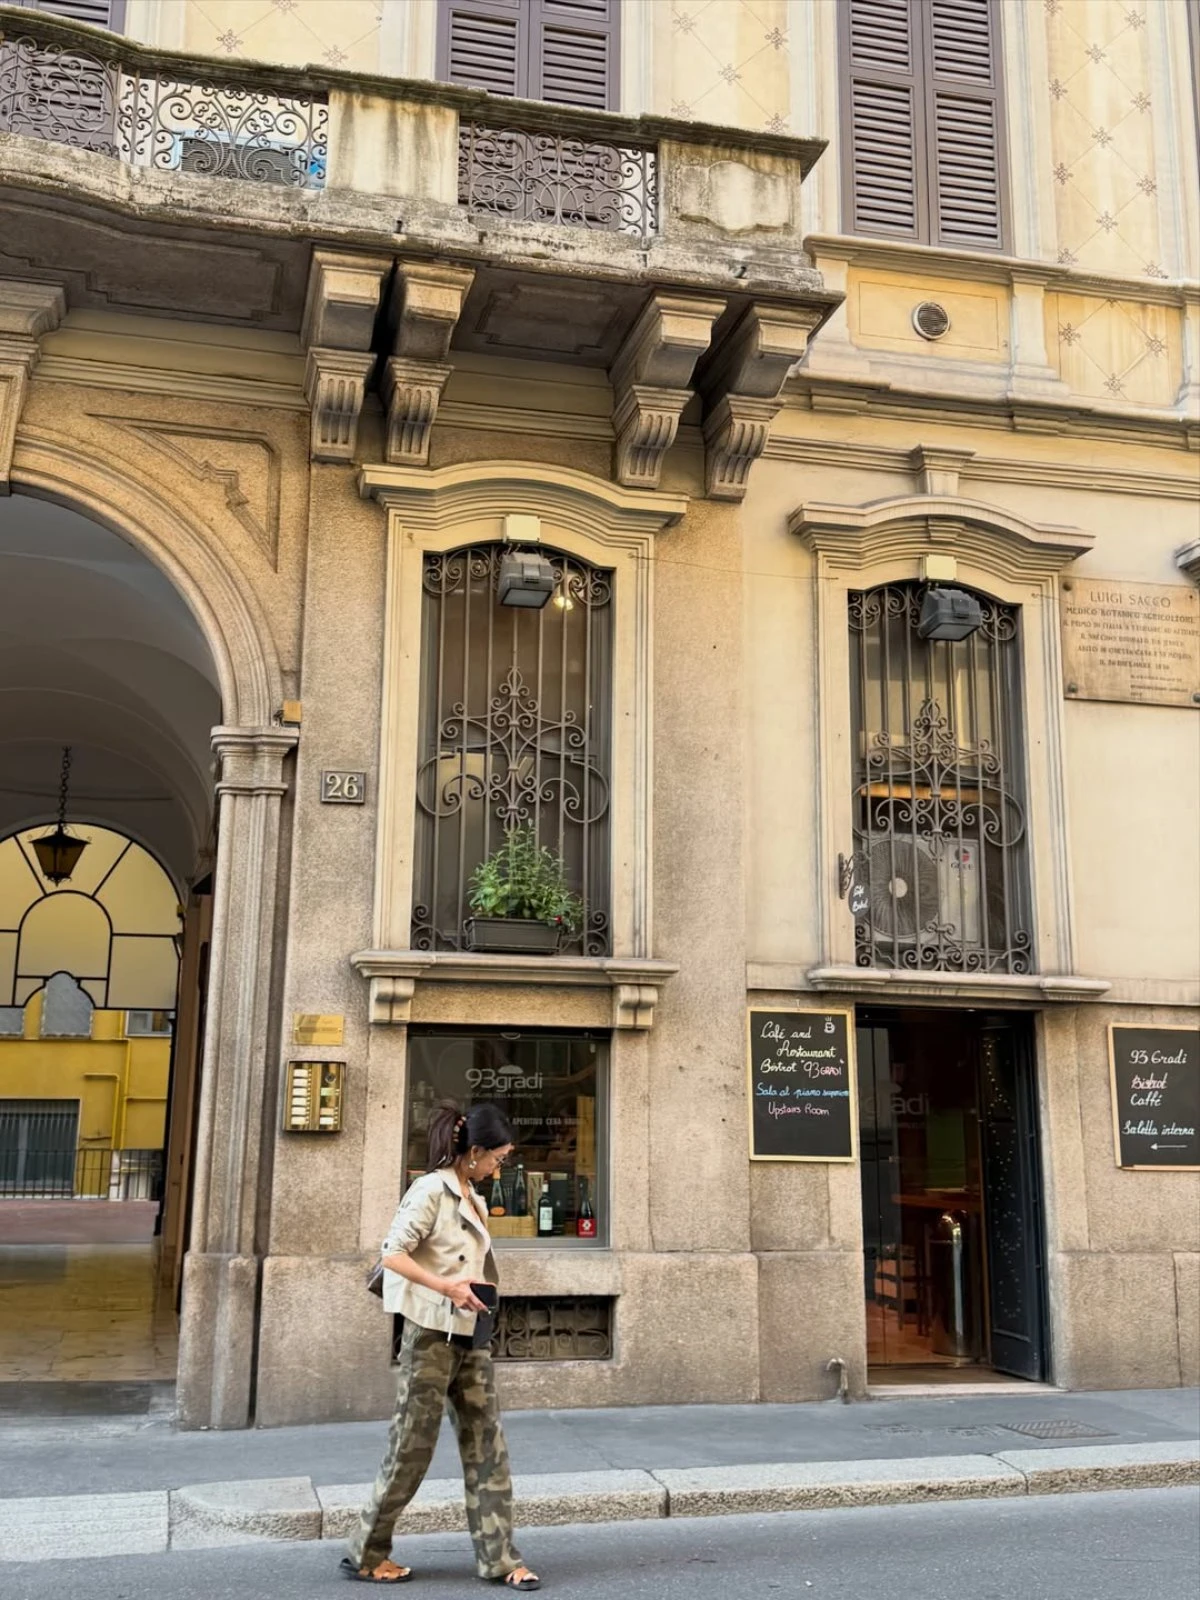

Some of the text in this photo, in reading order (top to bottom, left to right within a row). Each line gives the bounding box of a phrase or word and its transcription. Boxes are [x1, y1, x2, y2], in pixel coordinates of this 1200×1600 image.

[1090, 591, 1172, 609] LUIGI SACCO
[1066, 607, 1098, 616] MEDICO
[326, 773, 358, 798] 26
[760, 1020, 812, 1042] Café and
[776, 1040, 836, 1058] Restaurant
[1129, 1049, 1188, 1065] 93 Gradi
[465, 1068, 543, 1092] 93gradi
[756, 1082, 778, 1096] Sala
[779, 1085, 790, 1097] al
[794, 1088, 821, 1099] piano
[805, 1103, 829, 1116] Room
[1161, 1123, 1195, 1136] interna
